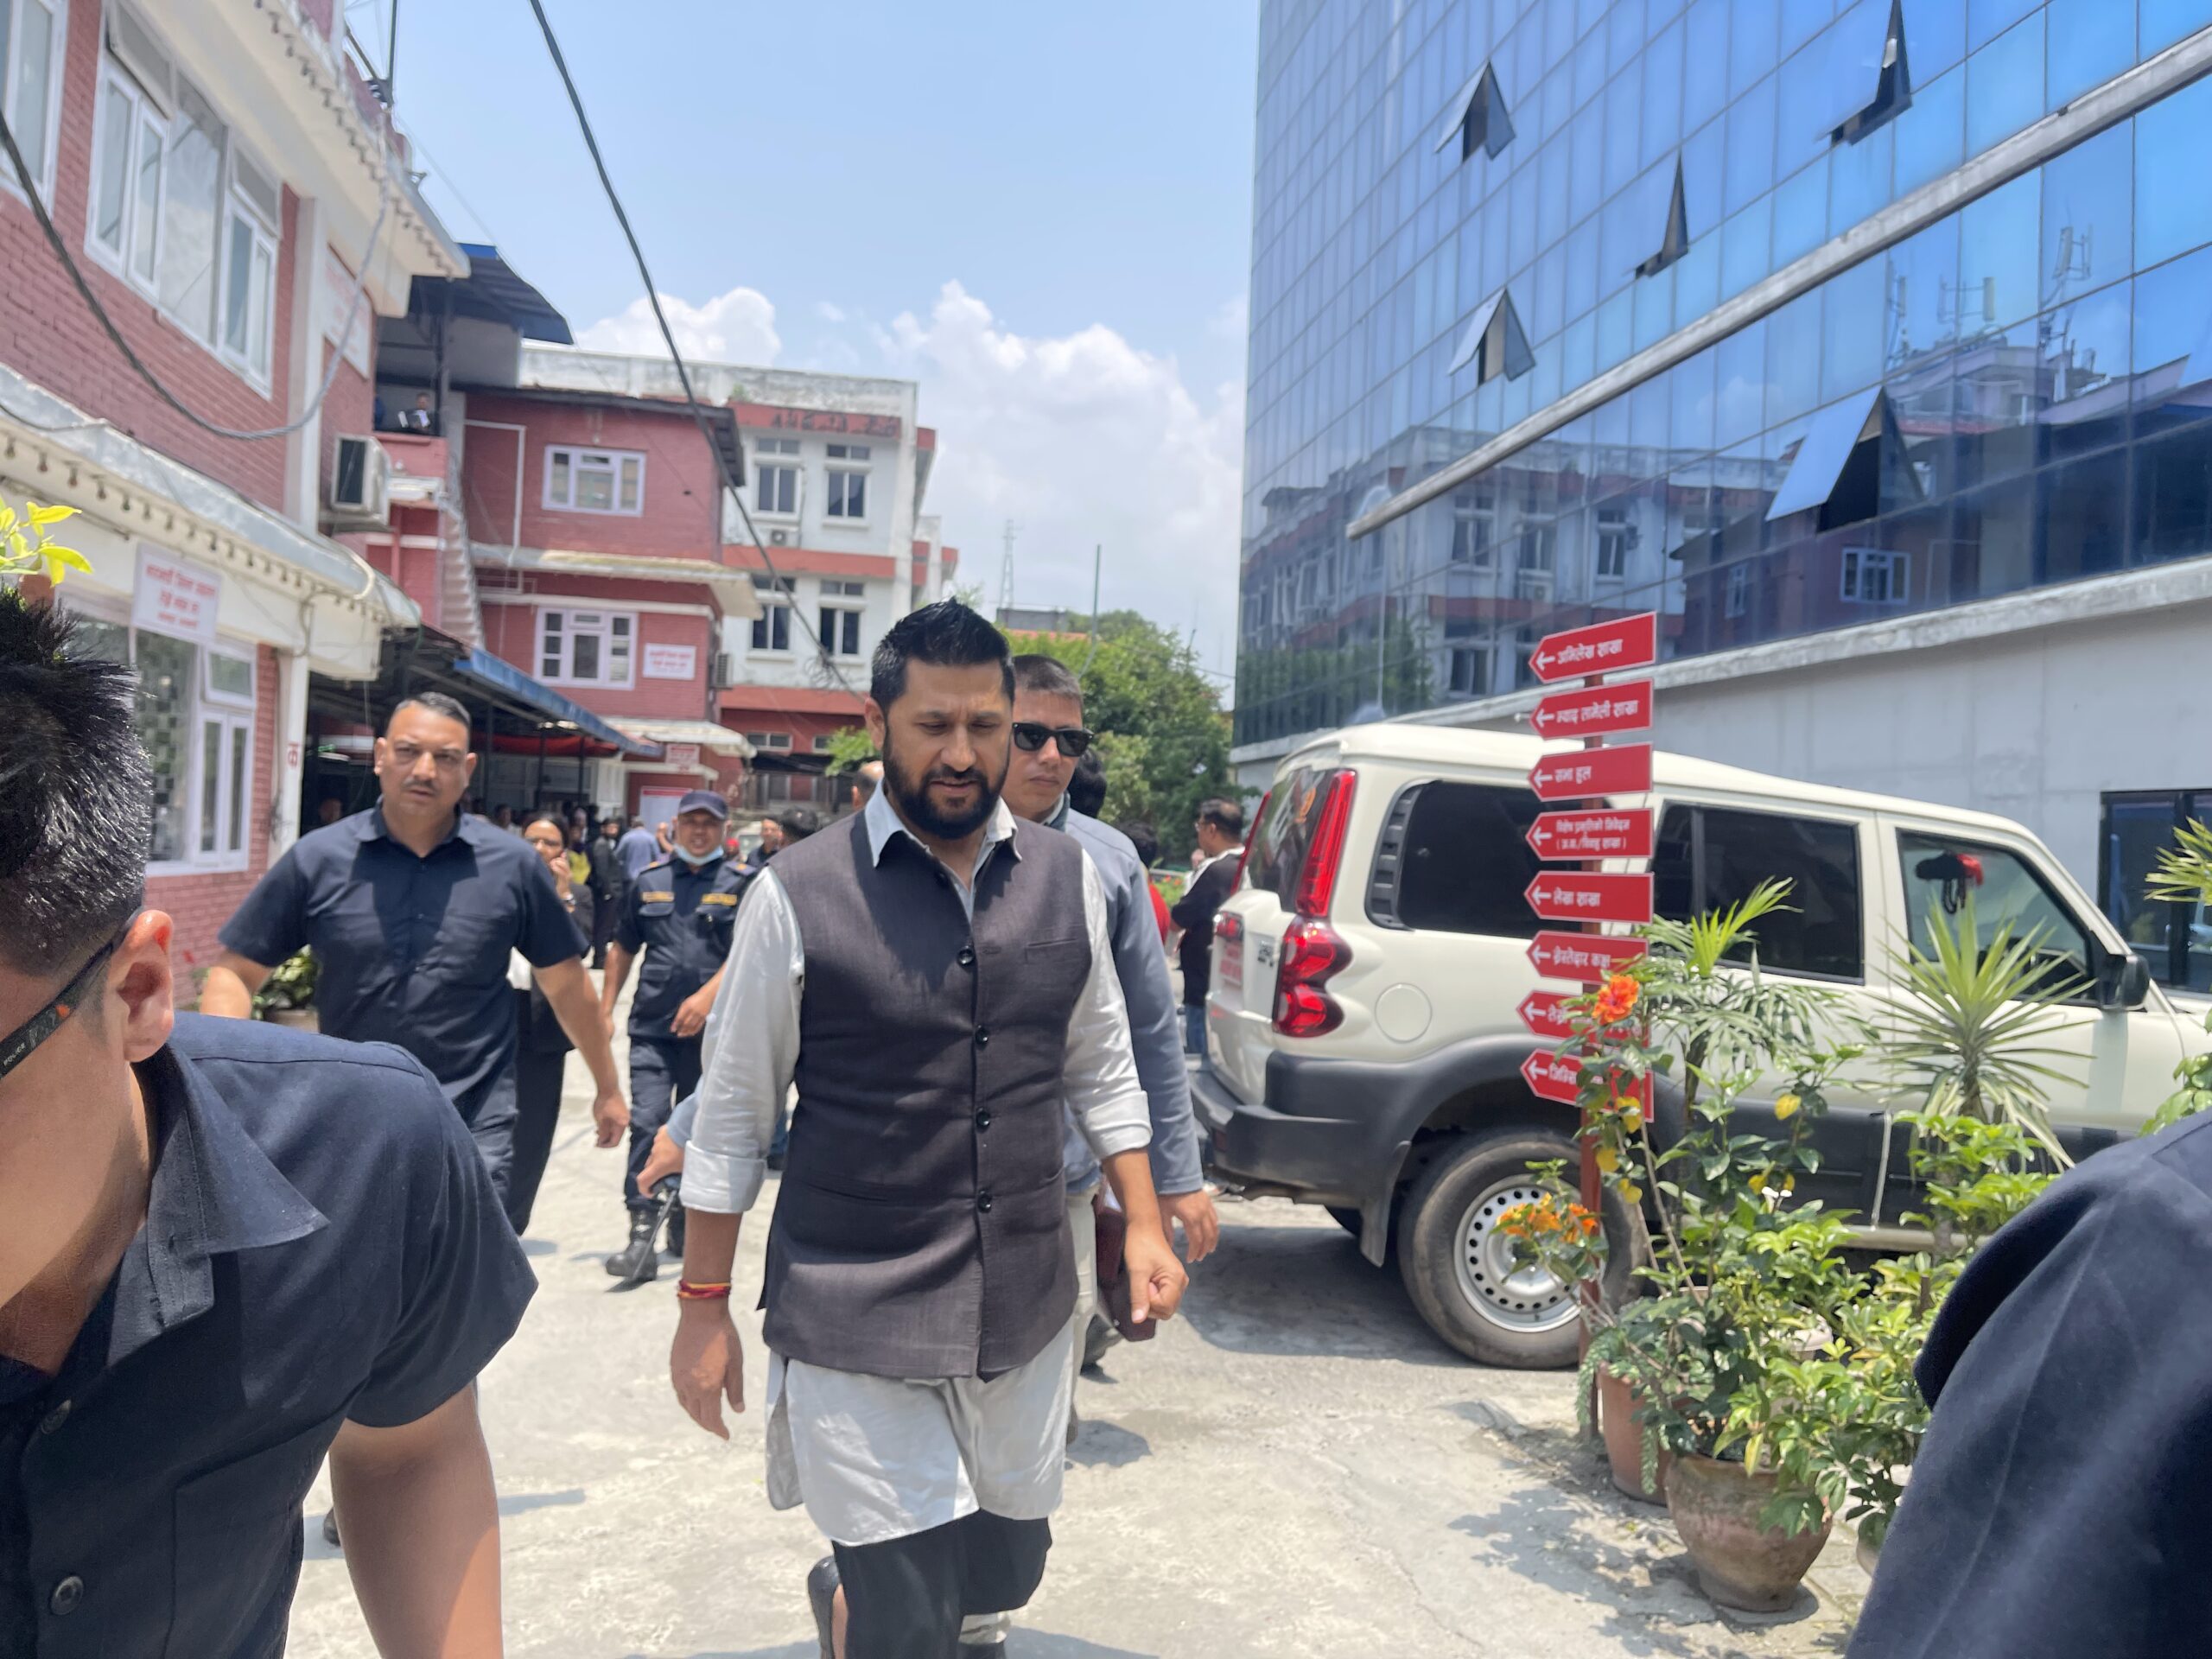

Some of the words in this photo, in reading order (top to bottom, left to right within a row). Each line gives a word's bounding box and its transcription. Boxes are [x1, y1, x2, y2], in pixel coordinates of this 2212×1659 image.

[1557, 643, 1595, 664] अभिलेख
[1597, 639, 1624, 658] शाखा
[1581, 700, 1611, 721] तामेली
[1613, 700, 1639, 718] शाखा
[1554, 887, 1574, 906] लेखा
[1576, 892, 1601, 907] शाखा
[3, 1042, 25, 1066] POLICE
